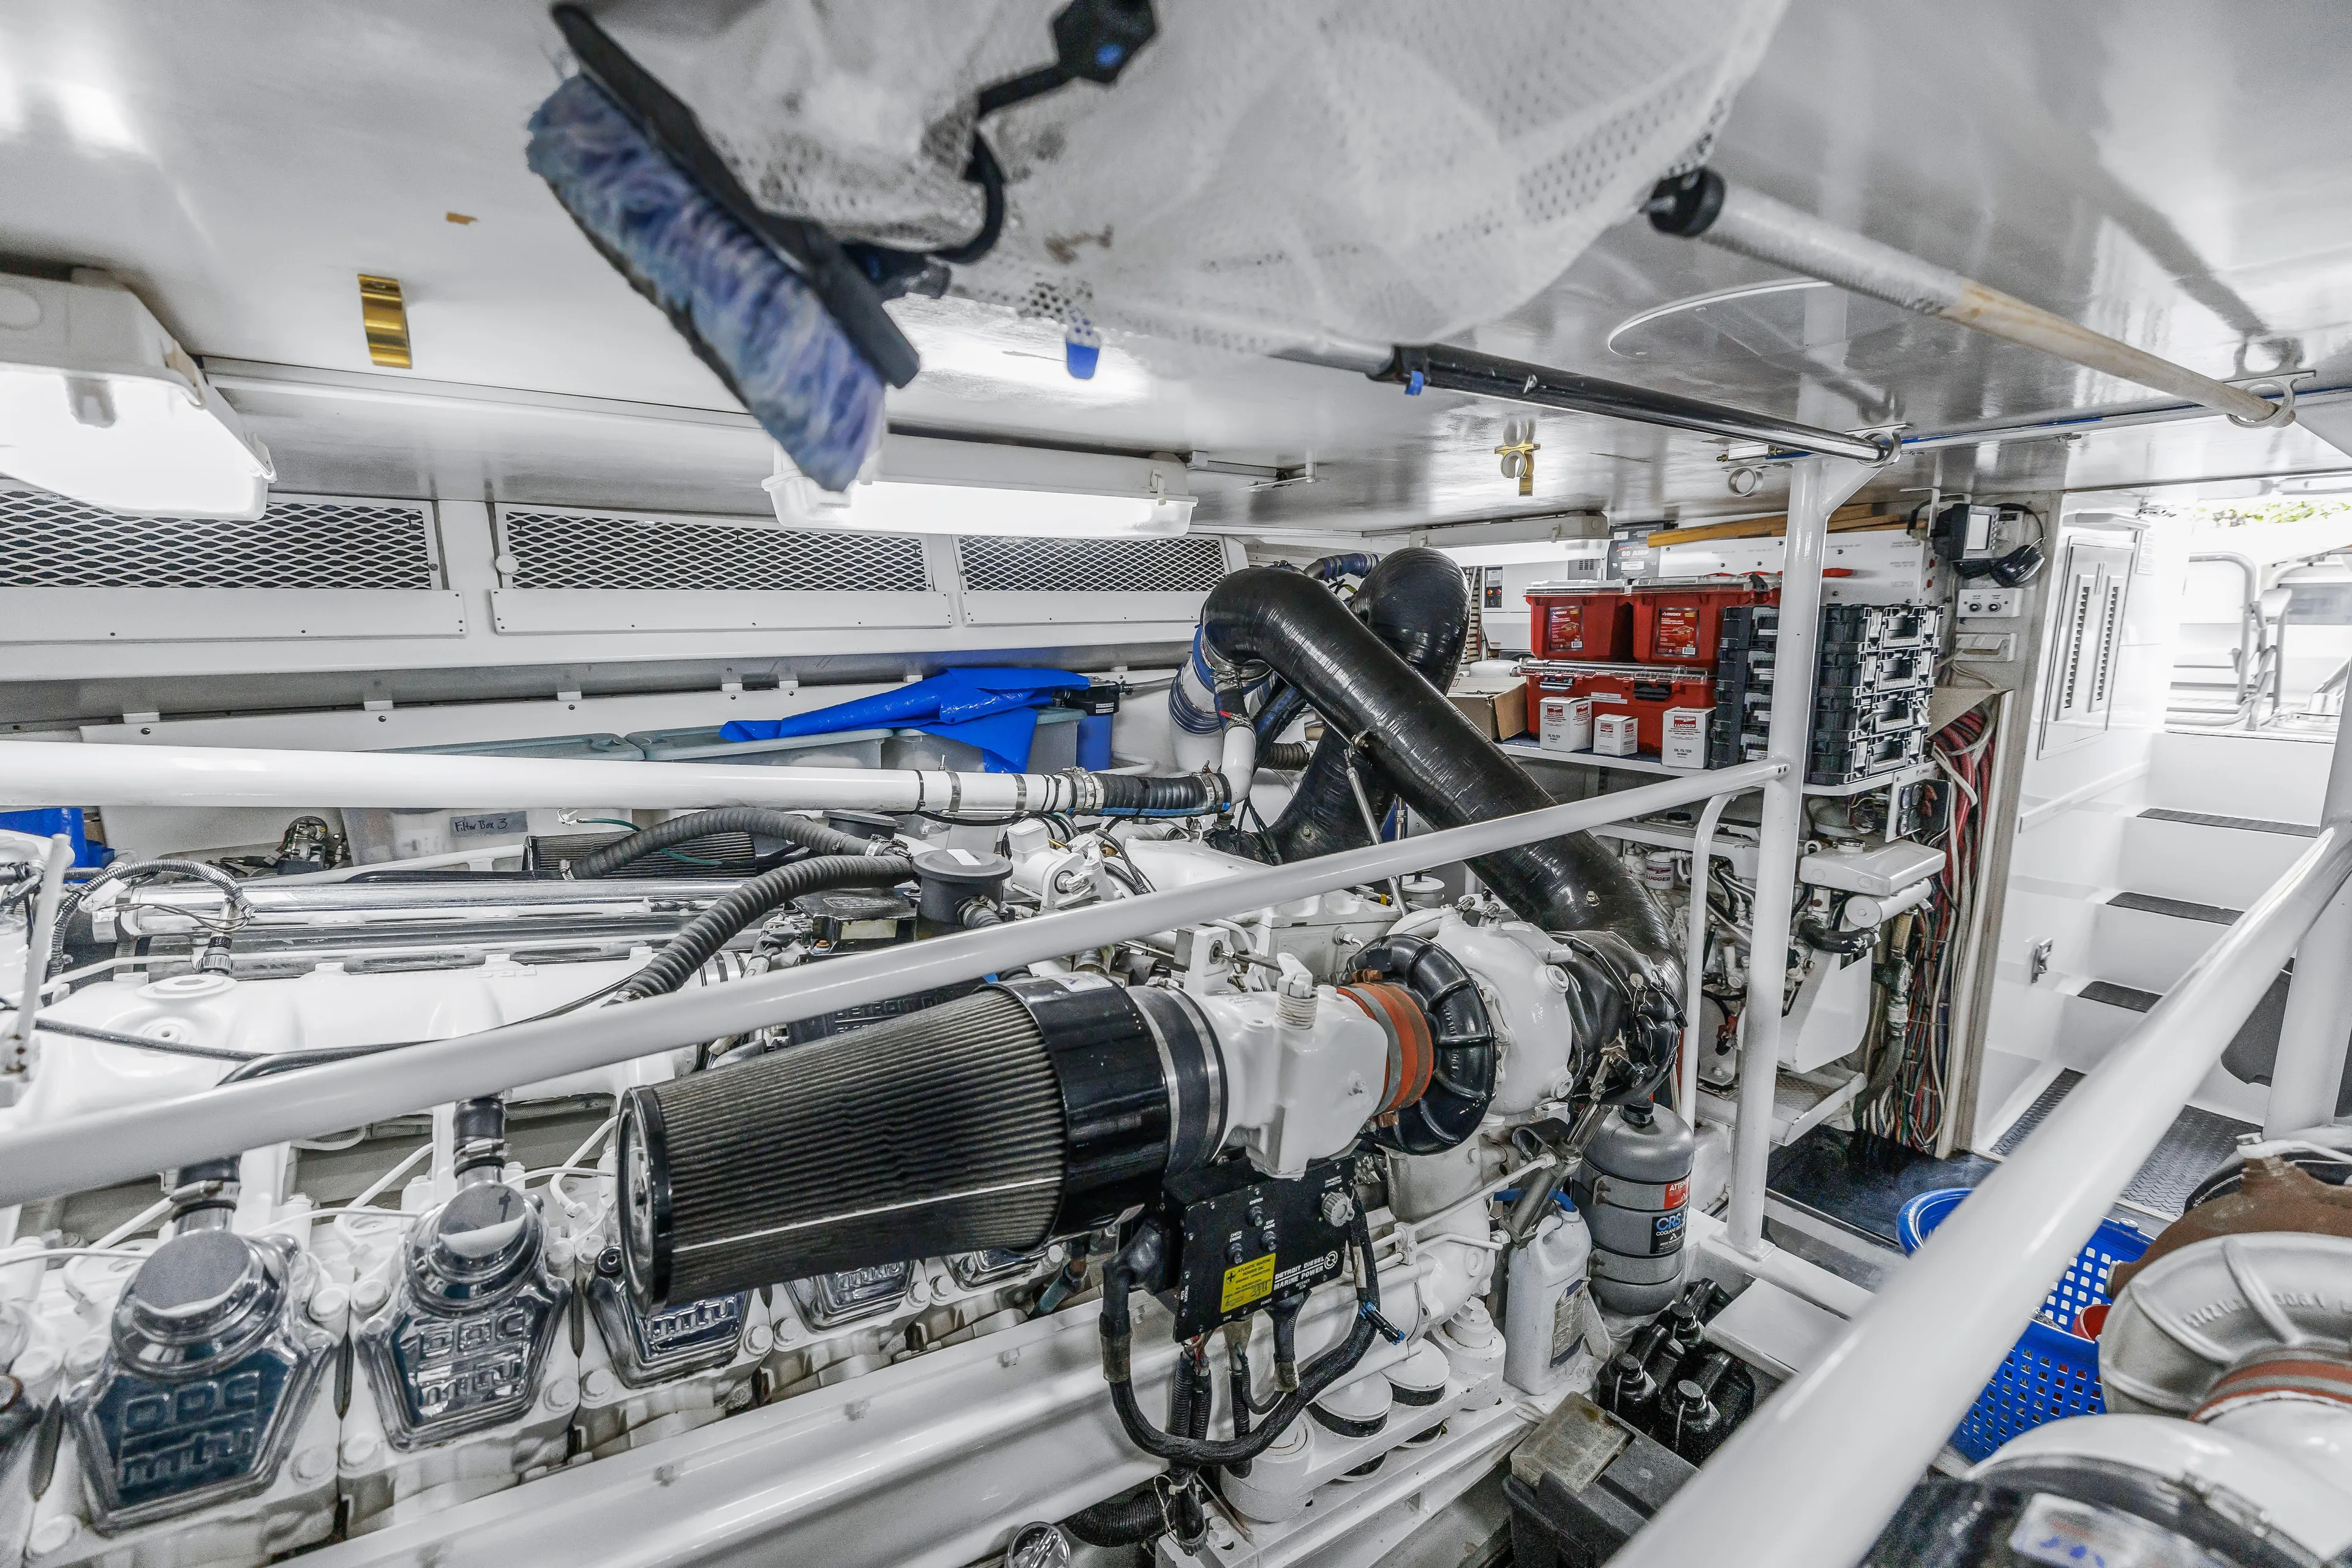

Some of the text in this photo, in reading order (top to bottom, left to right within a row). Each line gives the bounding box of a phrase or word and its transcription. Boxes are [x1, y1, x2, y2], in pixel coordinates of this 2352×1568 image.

[454, 818, 508, 832] Filter Box 3
[1274, 1275, 1299, 1291] MARINE
[1301, 1265, 1324, 1280] POWER
[1275, 1256, 1324, 1280] DETROIT DIESEL
